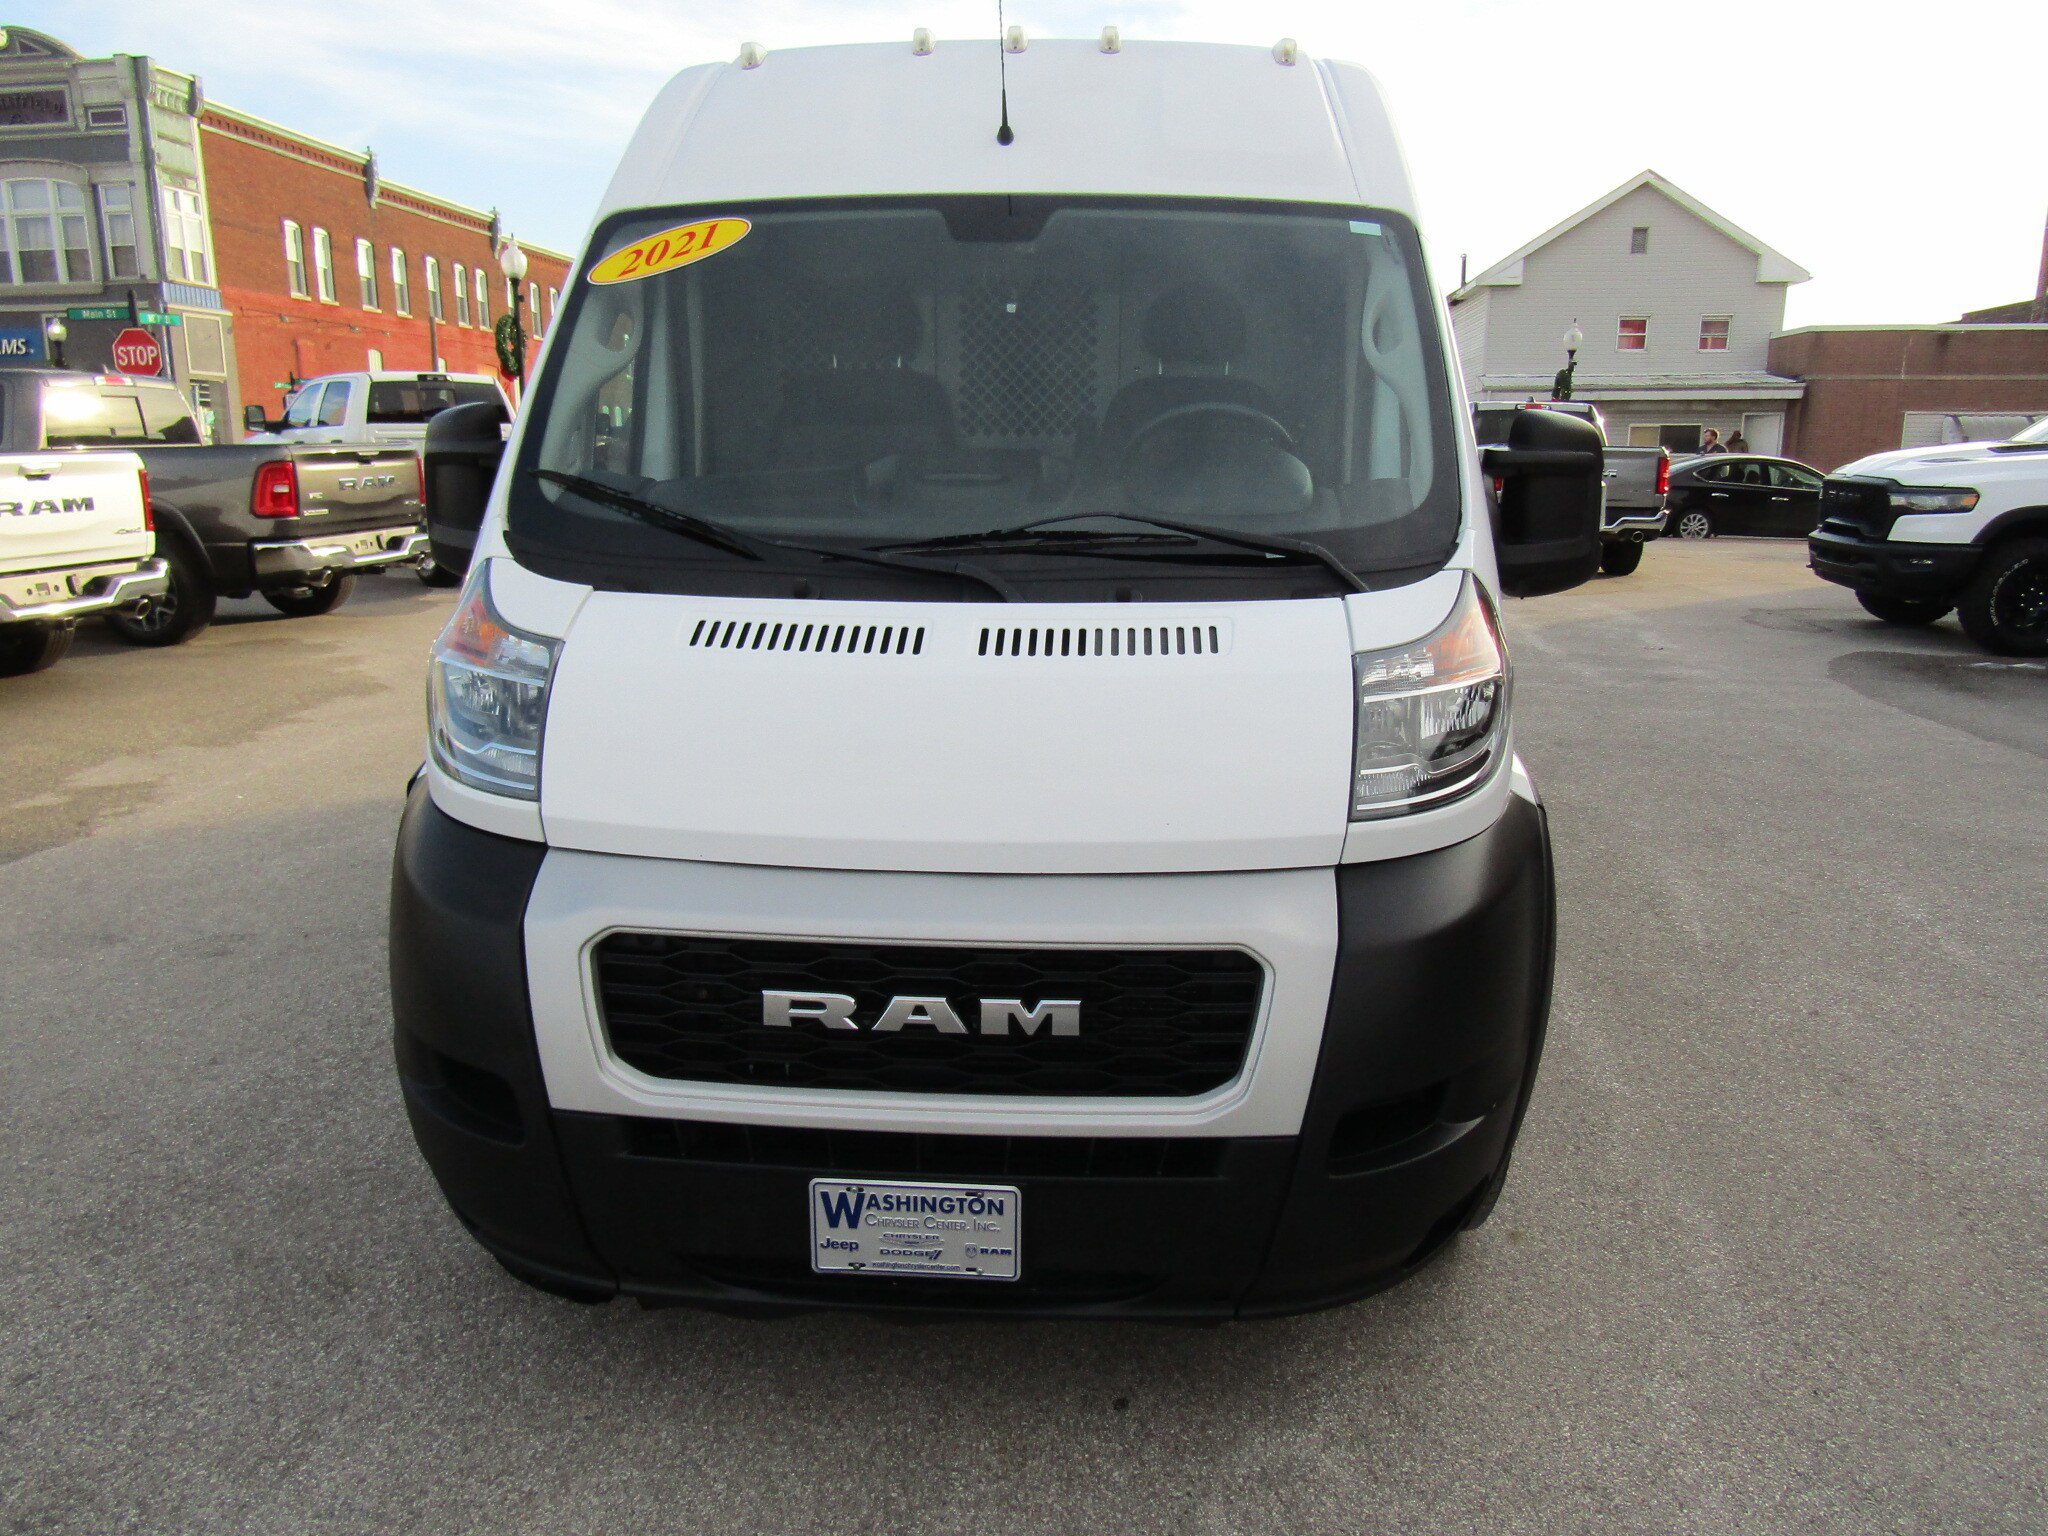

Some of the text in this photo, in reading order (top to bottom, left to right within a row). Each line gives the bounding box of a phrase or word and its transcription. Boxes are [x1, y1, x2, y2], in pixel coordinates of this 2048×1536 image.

[617, 222, 719, 279] 2021
[82, 310, 117, 319] Main St
[118, 345, 159, 367] STOP
[0, 497, 95, 516] RAM
[761, 990, 1082, 1036] RAM
[820, 1190, 1004, 1230] WASHINGTON
[865, 1213, 920, 1229] CHRYSLER
[882, 1232, 940, 1240] CHRYSLER
[820, 1237, 859, 1252] Jeep
[880, 1248, 935, 1257] DODGE
[980, 1247, 1012, 1256] RAM
